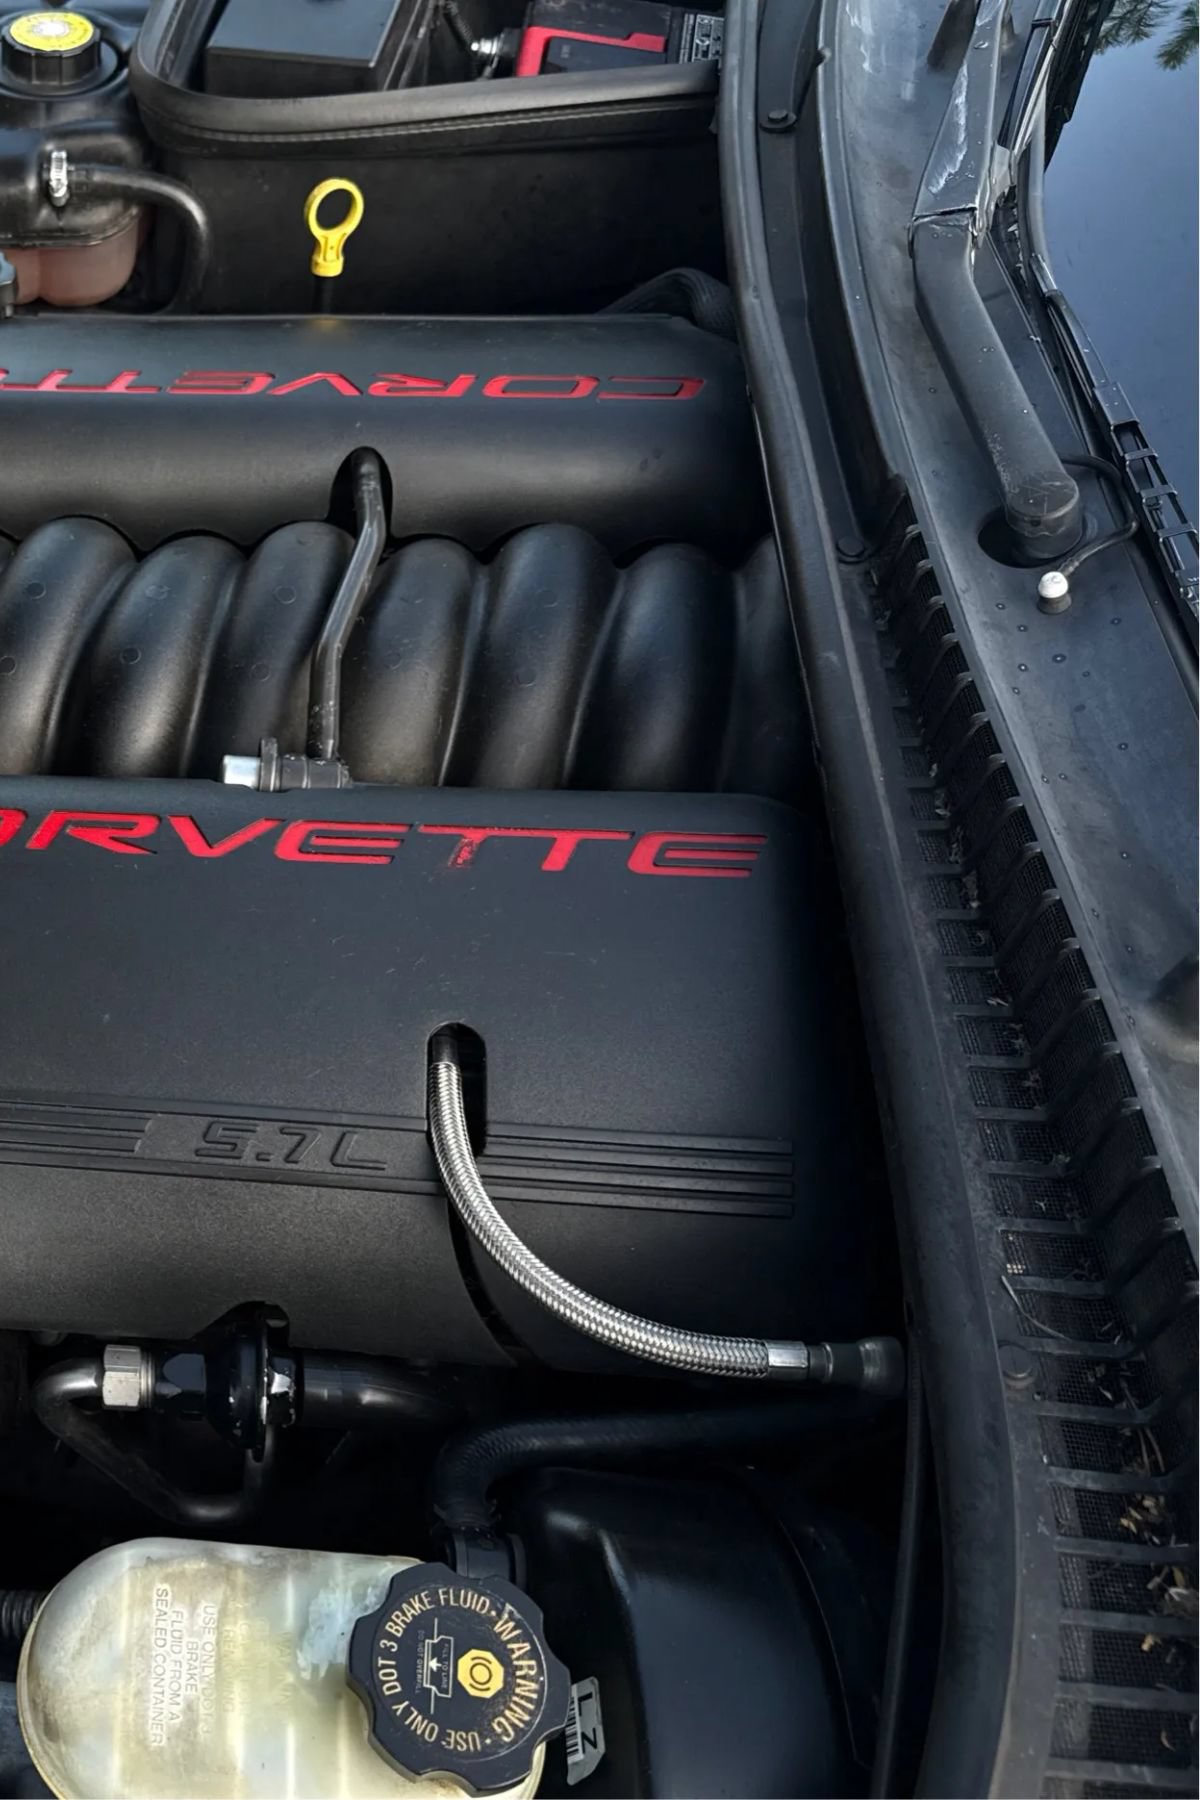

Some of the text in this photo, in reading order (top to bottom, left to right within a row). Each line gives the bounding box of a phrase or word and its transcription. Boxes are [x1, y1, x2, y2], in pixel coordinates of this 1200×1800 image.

[195, 1121, 388, 1171] 5.7L
[201, 1641, 215, 1680] ONLY
[202, 1605, 215, 1635] USE
[150, 1588, 168, 1745] SEALED CONTAINER
[168, 1610, 183, 1721] FLUID FROM A
[185, 1641, 199, 1693] BRAKE
[378, 1588, 490, 1751] USE ONLY DOT 3 BRAKE FLUID
[492, 1613, 539, 1743] WARNING
